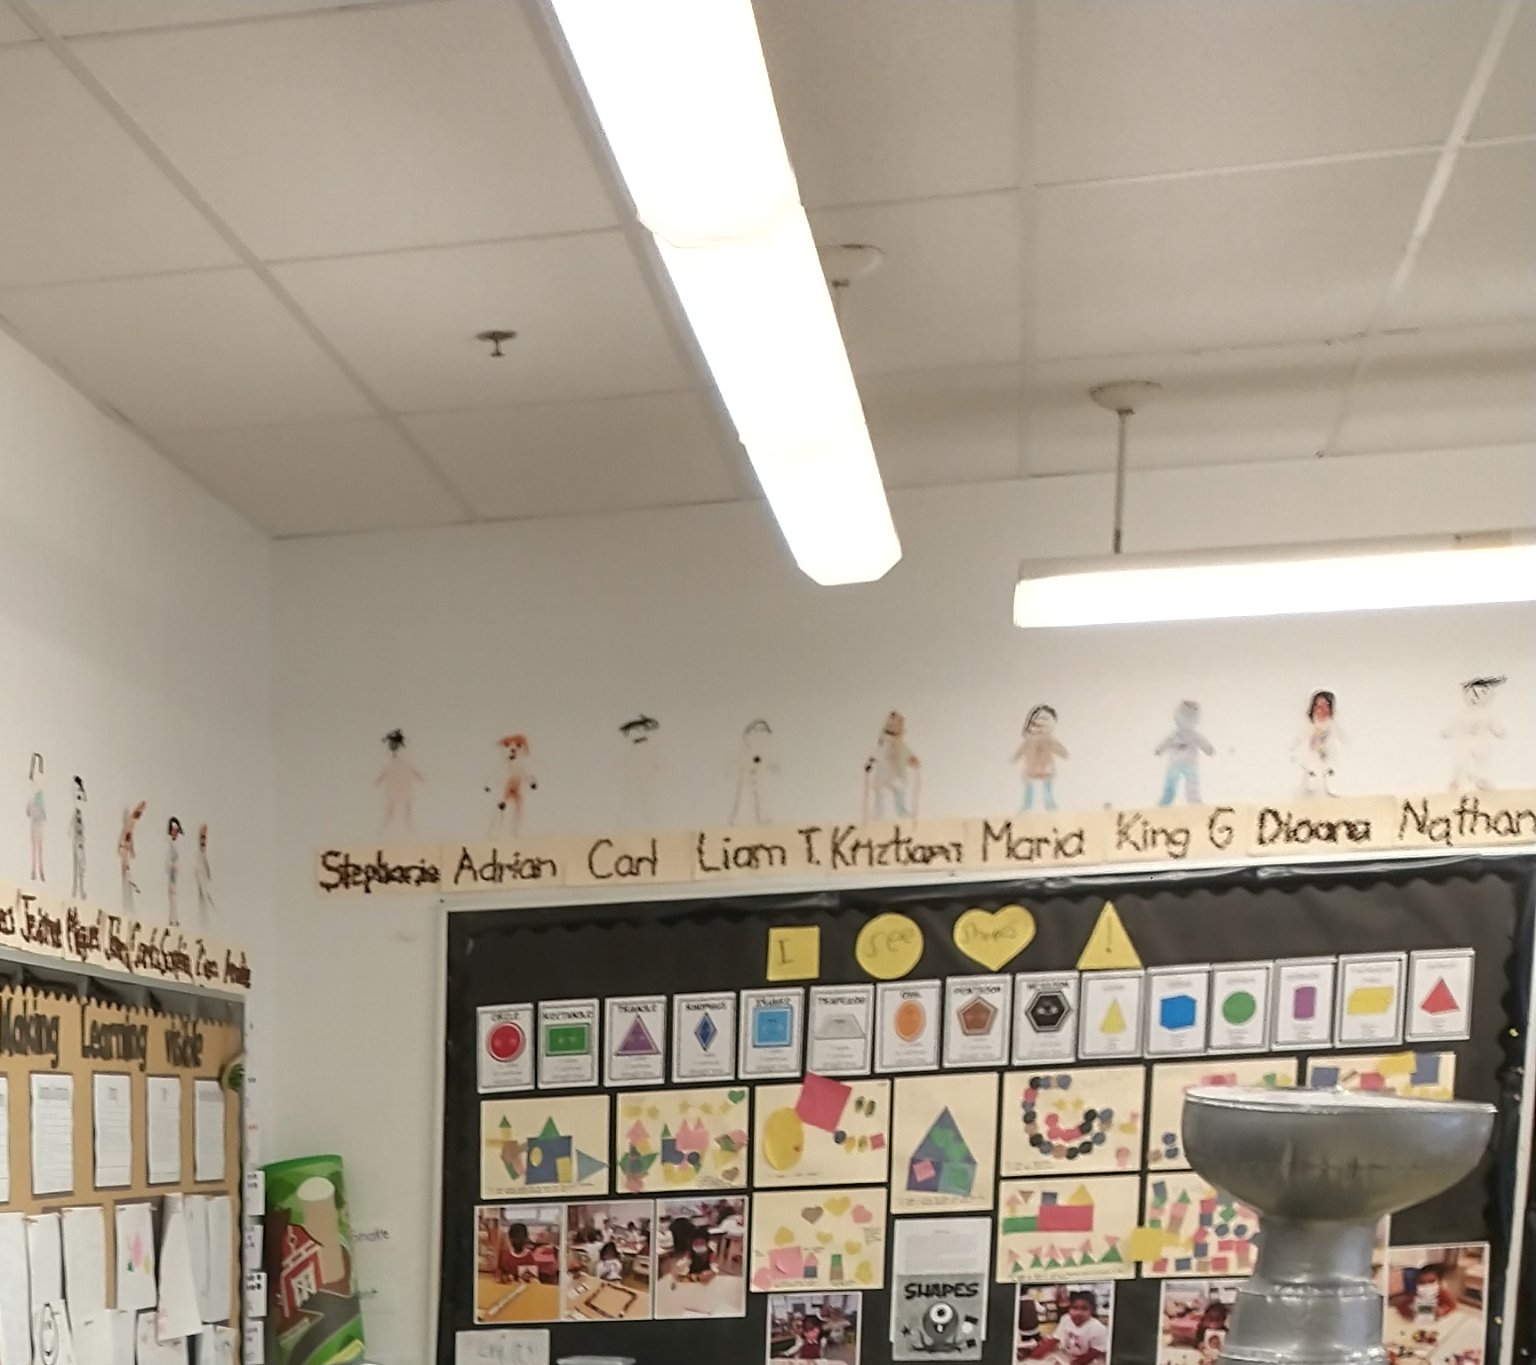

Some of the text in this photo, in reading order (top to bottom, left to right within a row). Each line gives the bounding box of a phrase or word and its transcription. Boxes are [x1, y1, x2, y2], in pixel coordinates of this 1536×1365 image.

[694, 830, 788, 873] Liam
[981, 819, 1086, 865] Maria
[1114, 809, 1192, 860] King
[452, 845, 558, 886] Adrian
[586, 838, 660, 878] Carl
[80, 999, 148, 1072] Learning
[904, 1280, 979, 1301] SHAPES
